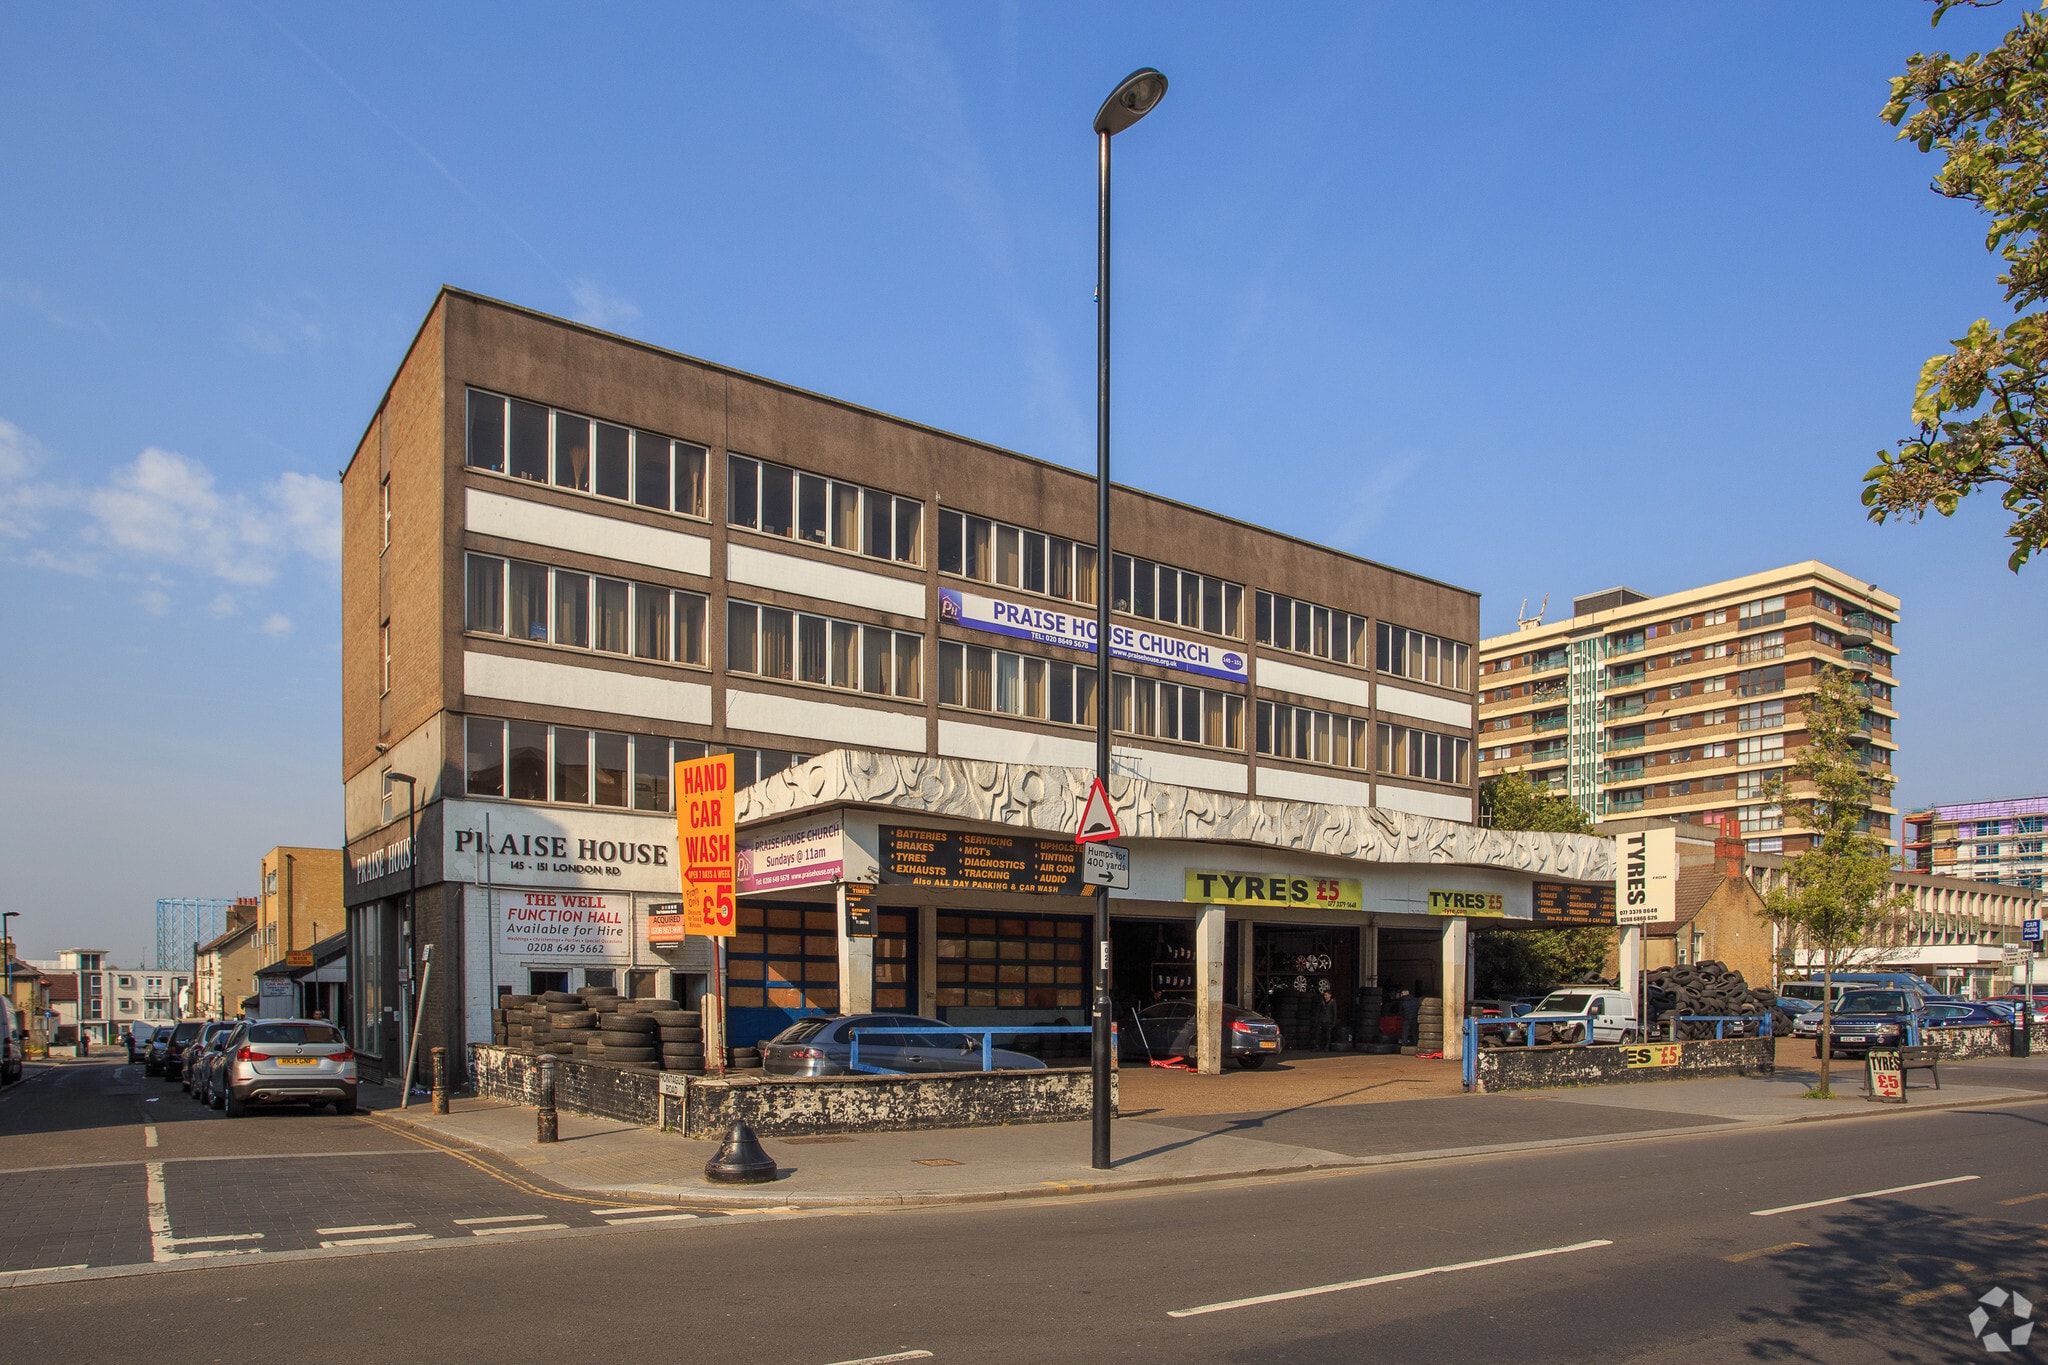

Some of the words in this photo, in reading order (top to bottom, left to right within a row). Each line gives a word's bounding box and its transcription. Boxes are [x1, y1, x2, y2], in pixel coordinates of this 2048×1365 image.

[993, 602, 1066, 632] PRAISE
[1072, 618, 1134, 648] HOSE
[1140, 633, 1210, 664] CHURCH
[1031, 632, 1044, 640] TEL:
[1045, 635, 1056, 643] 020
[1058, 636, 1072, 646] 8649
[1073, 640, 1088, 649] 5678
[1112, 648, 1177, 667] www.praisehouse.org.uk
[684, 763, 726, 794] HAND
[690, 800, 721, 828] CAR
[755, 838, 779, 852] PRAISE
[781, 831, 805, 848] HOUSE
[807, 824, 839, 842] CHURCH
[896, 830, 947, 841] BATTERIES
[964, 835, 1013, 847] SERVICING
[578, 838, 668, 866] HOUSE
[686, 835, 730, 863] WASH
[896, 842, 935, 852] BRAKES
[964, 847, 990, 856] MOT's
[1040, 842, 1084, 853] UPHOLSTE
[1088, 847, 1113, 859] Humps
[1116, 852, 1125, 860] for
[766, 853, 794, 867] Sundays
[797, 850, 803, 863] @
[805, 847, 826, 860] 11am
[896, 853, 927, 863] TYRES
[1040, 853, 1074, 863] TINTING
[357, 848, 384, 884] PRAISE
[511, 861, 524, 870] 145
[537, 863, 548, 871] 151
[553, 863, 603, 875] LONDON
[606, 867, 621, 876] RD
[896, 865, 946, 876] EXHAUSTS
[964, 858, 1025, 870] DIAGNOSTICS
[1040, 864, 1054, 872] AIR
[1056, 865, 1075, 874] CON
[1087, 858, 1103, 867] 400
[1106, 862, 1125, 871] yards
[1627, 832, 1645, 905] TYRES
[964, 869, 1010, 880] TRACKING
[1040, 874, 1067, 883] AUDIO
[953, 880, 970, 888] DAY
[972, 881, 1007, 890] PARKING
[1197, 874, 1308, 902] TYRES
[1316, 879, 1339, 900] £5
[524, 894, 556, 906] THE
[561, 895, 606, 908] WELL
[703, 885, 733, 926] £5
[1430, 892, 1485, 909] TYRES
[1489, 895, 1502, 909] £5
[508, 908, 582, 922] FUNCTION
[587, 911, 622, 924] HALL
[506, 924, 569, 934] Available
[573, 925, 593, 937] for
[597, 926, 623, 936] Hire
[527, 943, 553, 952] 0208
[557, 944, 575, 952] 649
[580, 944, 604, 953] 5662
[1661, 1046, 1677, 1064] £5
[1870, 1057, 1900, 1071] TYRES
[1878, 1075, 1898, 1088] £5
[666, 1084, 677, 1094] ROAD
